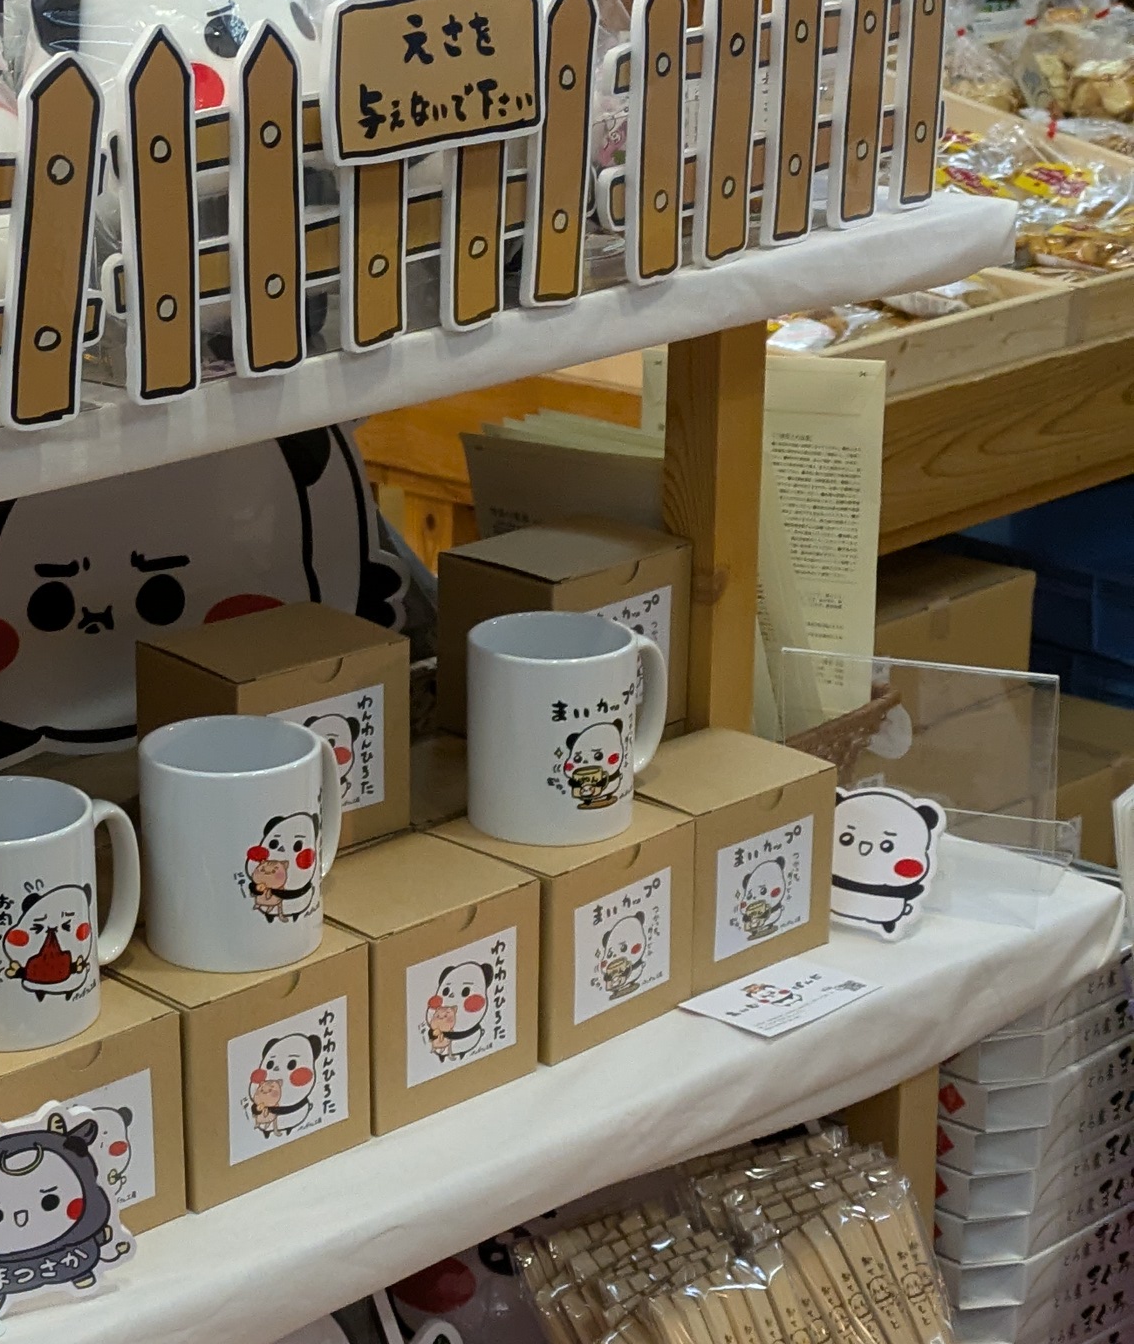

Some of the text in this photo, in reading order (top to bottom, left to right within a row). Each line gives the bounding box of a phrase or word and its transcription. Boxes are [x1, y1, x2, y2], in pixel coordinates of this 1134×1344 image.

[402, 12, 496, 65] えさを
[357, 77, 533, 140] 与えないで下さい
